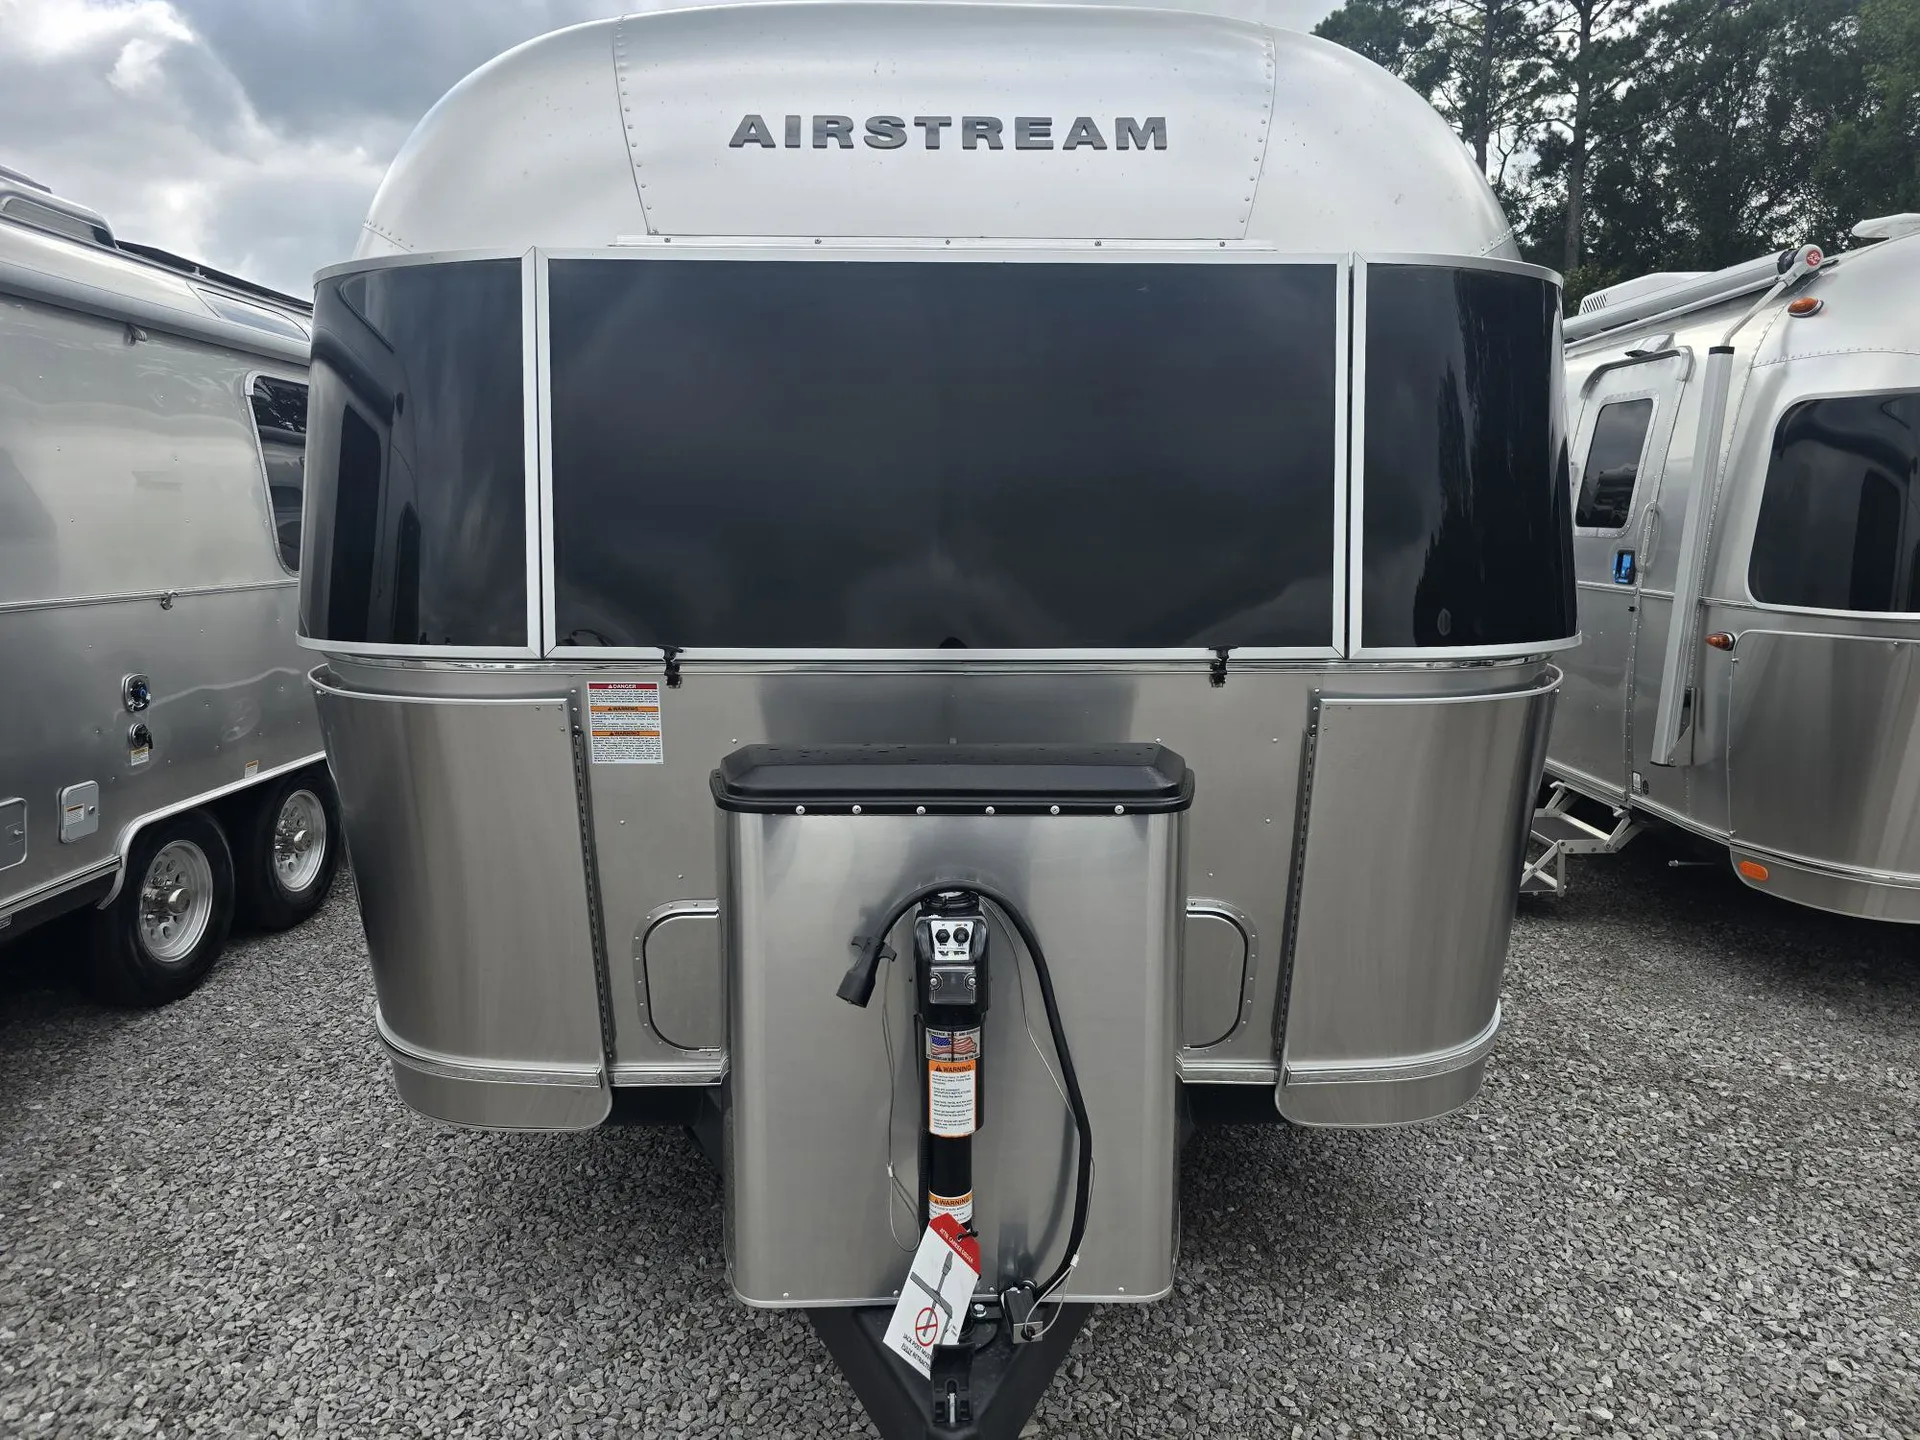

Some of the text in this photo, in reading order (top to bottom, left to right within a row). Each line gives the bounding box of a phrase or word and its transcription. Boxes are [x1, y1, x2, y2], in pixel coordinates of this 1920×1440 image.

[729, 114, 1167, 150] AIRSTREAM
[942, 1064, 972, 1073] WARNING
[939, 1197, 969, 1206] WARNING
